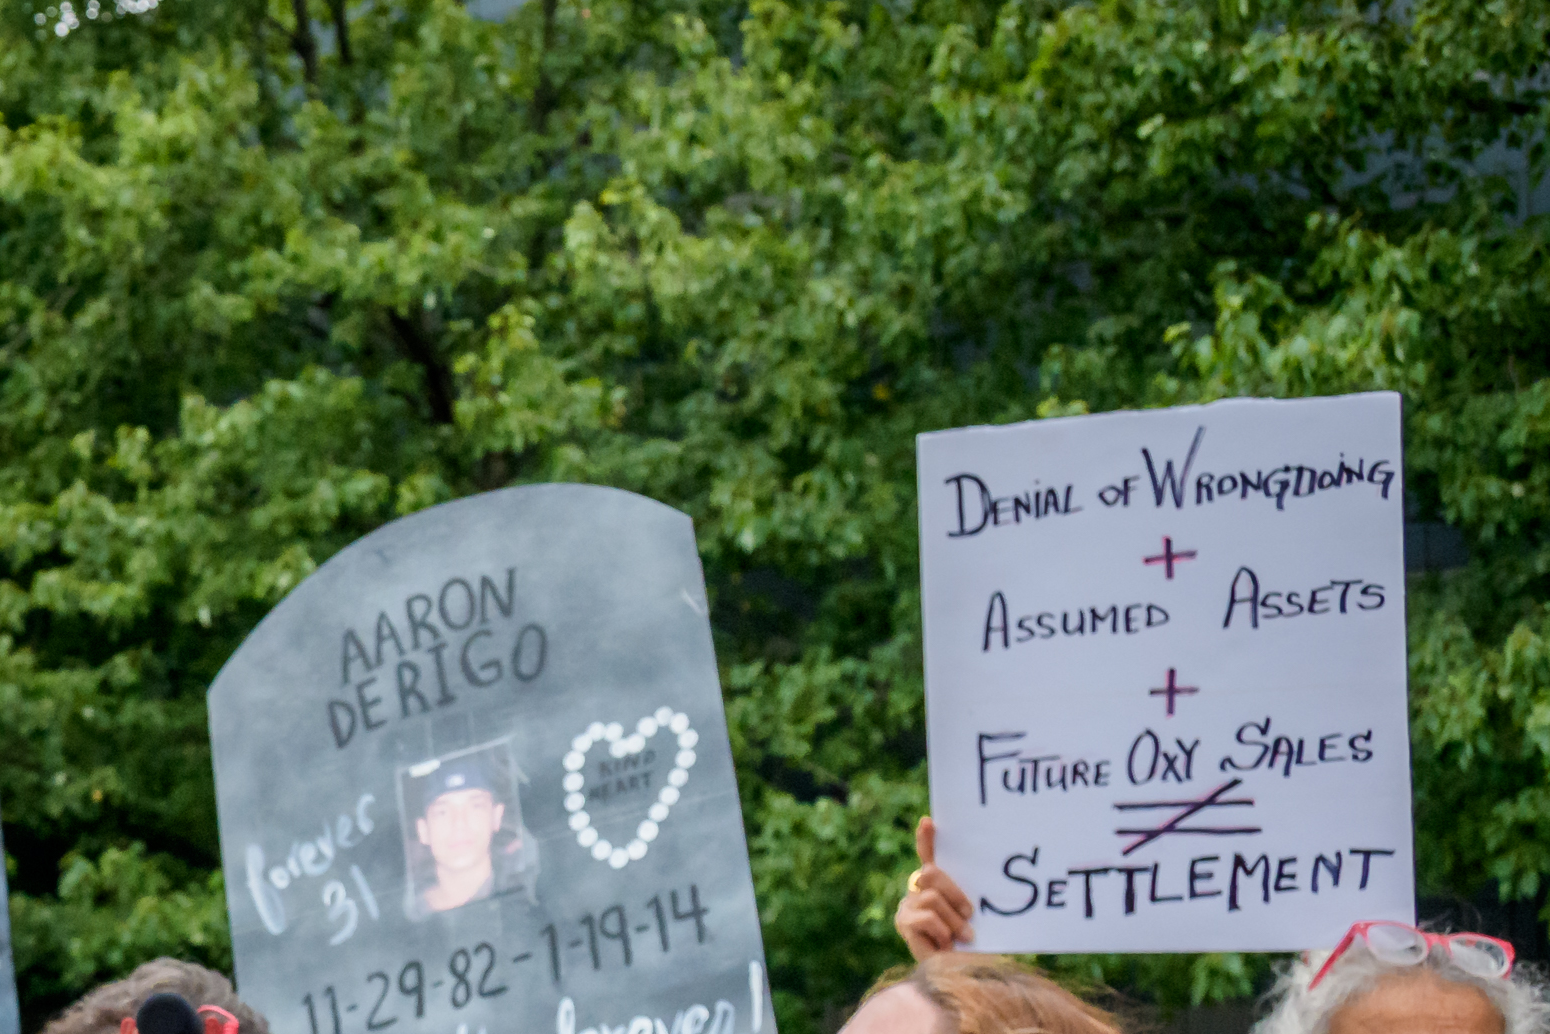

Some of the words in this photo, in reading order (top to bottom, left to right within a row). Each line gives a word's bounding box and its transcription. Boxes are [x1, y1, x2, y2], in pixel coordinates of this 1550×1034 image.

[944, 472, 1083, 538] DENIAL
[1143, 537, 1197, 579] +
[341, 566, 517, 687] AARON
[982, 591, 1170, 652] ASSUMED
[1223, 566, 1386, 629] ASSETS
[1149, 668, 1199, 716] +
[977, 731, 1110, 805] FUTURE
[1219, 717, 1373, 778] SALES
[323, 864, 380, 946] 31
[979, 848, 1396, 919] SETTLEMENT
